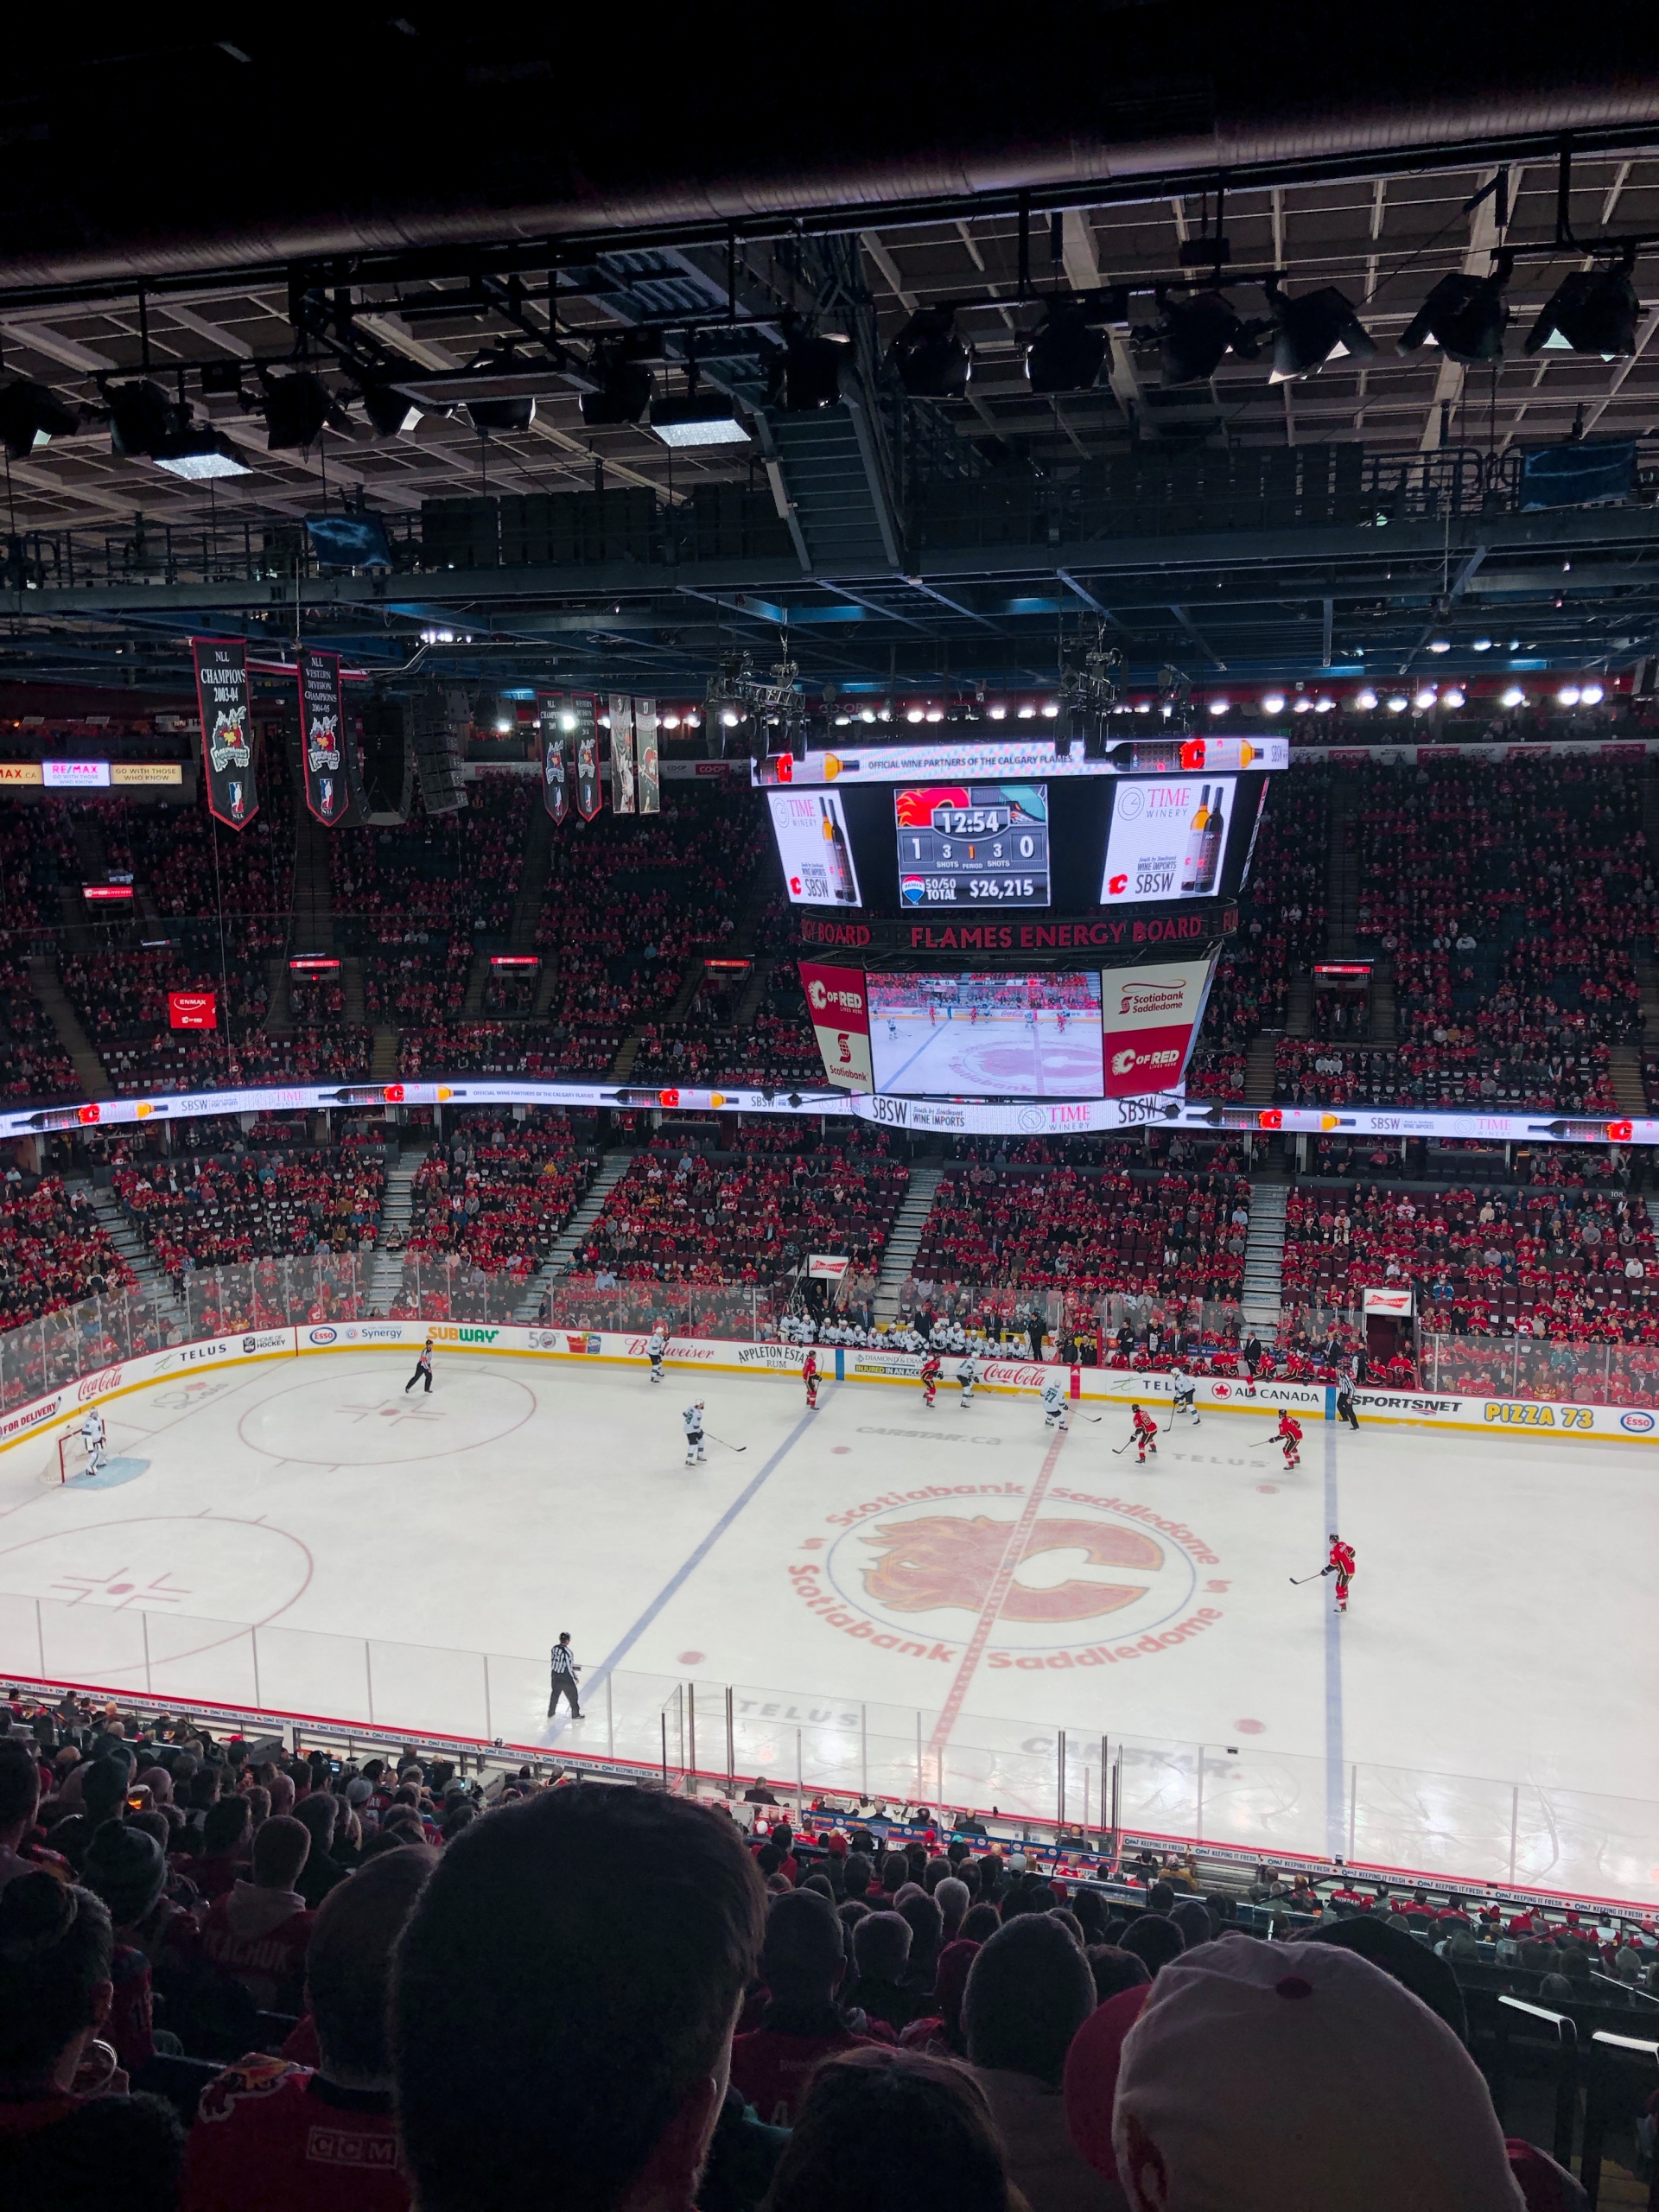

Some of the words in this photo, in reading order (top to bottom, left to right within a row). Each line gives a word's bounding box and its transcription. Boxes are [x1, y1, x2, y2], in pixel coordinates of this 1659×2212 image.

[215, 651, 230, 663] NLL
[311, 657, 323, 668] NLL
[200, 668, 246, 684] CHAMPIONS
[308, 680, 332, 691] DIVISION
[213, 687, 238, 702] 2003-04
[304, 691, 337, 702] CHAMPIONS
[868, 761, 900, 770] OFFICIAL
[924, 758, 965, 767] PARTNERS
[998, 756, 1038, 765] CALGARY
[1039, 754, 1073, 764] FLAMES
[53, 766, 98, 774] RE/MAX
[1147, 788, 1191, 807] TIME
[787, 799, 816, 817] TIME
[1147, 809, 1188, 818] WINERY
[942, 810, 1000, 833] 12:54
[912, 838, 921, 860] 1
[943, 844, 952, 859] 3
[969, 844, 976, 860] 1
[993, 843, 1002, 858] 3
[1020, 836, 1034, 858] 0
[1153, 861, 1177, 870] IMPORTS
[804, 878, 830, 898] SBSW
[925, 879, 957, 888] 50/50
[969, 880, 1034, 899] $26,215
[1135, 873, 1174, 894] SBSW
[926, 889, 957, 900] TOTAL
[818, 922, 870, 946] BOARD
[912, 927, 1013, 948] FLAMES
[1020, 922, 1125, 947] ENERGY
[1133, 916, 1201, 943] BOARD
[827, 992, 838, 1003] OF
[838, 991, 862, 1009] RED
[1134, 991, 1184, 1004] Scotiabank
[1133, 1002, 1183, 1014] Saddledome
[1136, 1054, 1151, 1065] OF
[1151, 1050, 1179, 1065] RED
[830, 1065, 868, 1082] Scotiabank
[275, 1091, 302, 1102] TIME
[752, 1096, 774, 1108] SBSW
[181, 1100, 207, 1111] SBSW
[873, 1096, 907, 1122] SBSW
[913, 1106, 926, 1115] South
[1119, 1096, 1157, 1124] SBSW
[1046, 1105, 1090, 1123] TIME
[913, 1115, 931, 1124] WINE
[932, 1116, 965, 1127] IMPORTS
[1370, 1117, 1400, 1129] SBSW
[1477, 1118, 1511, 1130] TIME
[1369, 1297, 1406, 1306] Budweiser
[314, 1329, 333, 1339] Esso
[362, 1328, 402, 1338] Synergy
[426, 1326, 499, 1343] SUBWAY
[257, 1339, 286, 1349] HOCKEY
[180, 1344, 226, 1362] TELUS
[738, 1346, 782, 1363] APPLETON
[865, 1355, 899, 1363] DIAMOND
[766, 1359, 786, 1369] RUM
[983, 1363, 1049, 1387] Coca-Cola
[78, 1365, 124, 1402] Coca-Cola
[1045, 1390, 1057, 1403] 27
[1261, 1389, 1319, 1402] CANADA
[3, 1422, 19, 1434] FOR
[21, 1402, 56, 1426] DELIVERY
[1485, 1402, 1555, 1427] PIZZA
[1561, 1408, 1594, 1429] 73
[1625, 1415, 1651, 1428] Esso
[1173, 1452, 1267, 1468] TELUS
[826, 1482, 1026, 1527] Scotiabank
[1048, 1487, 1220, 1566] Saddledome
[788, 1564, 957, 1664] Scotiabank
[988, 1605, 1224, 1670] Saddledome
[740, 1699, 858, 1727] TELUS
[556, 1758, 573, 1766] KEEPING
[615, 1766, 632, 1775] KEEPING
[1141, 1840, 1161, 1849] KEEPING
[1168, 1843, 1184, 1852] FRESH
[1211, 1850, 1232, 1859] KEEPING
[1240, 1853, 1256, 1862] FRESH
[1284, 1860, 1306, 1869] KEEPING
[1313, 1864, 1330, 1872] FRESH
[1358, 1872, 1382, 1881] KEEPING
[1435, 1883, 1457, 1892] KEEPING
[1465, 1886, 1484, 1896] FRESH
[1513, 1894, 1536, 1904] KEEPING
[1544, 1898, 1562, 1908] FRESH
[1592, 1905, 1616, 1915] KEEPING
[1624, 1910, 1643, 1919] FRESH
[312, 2132, 394, 2161] CCM
